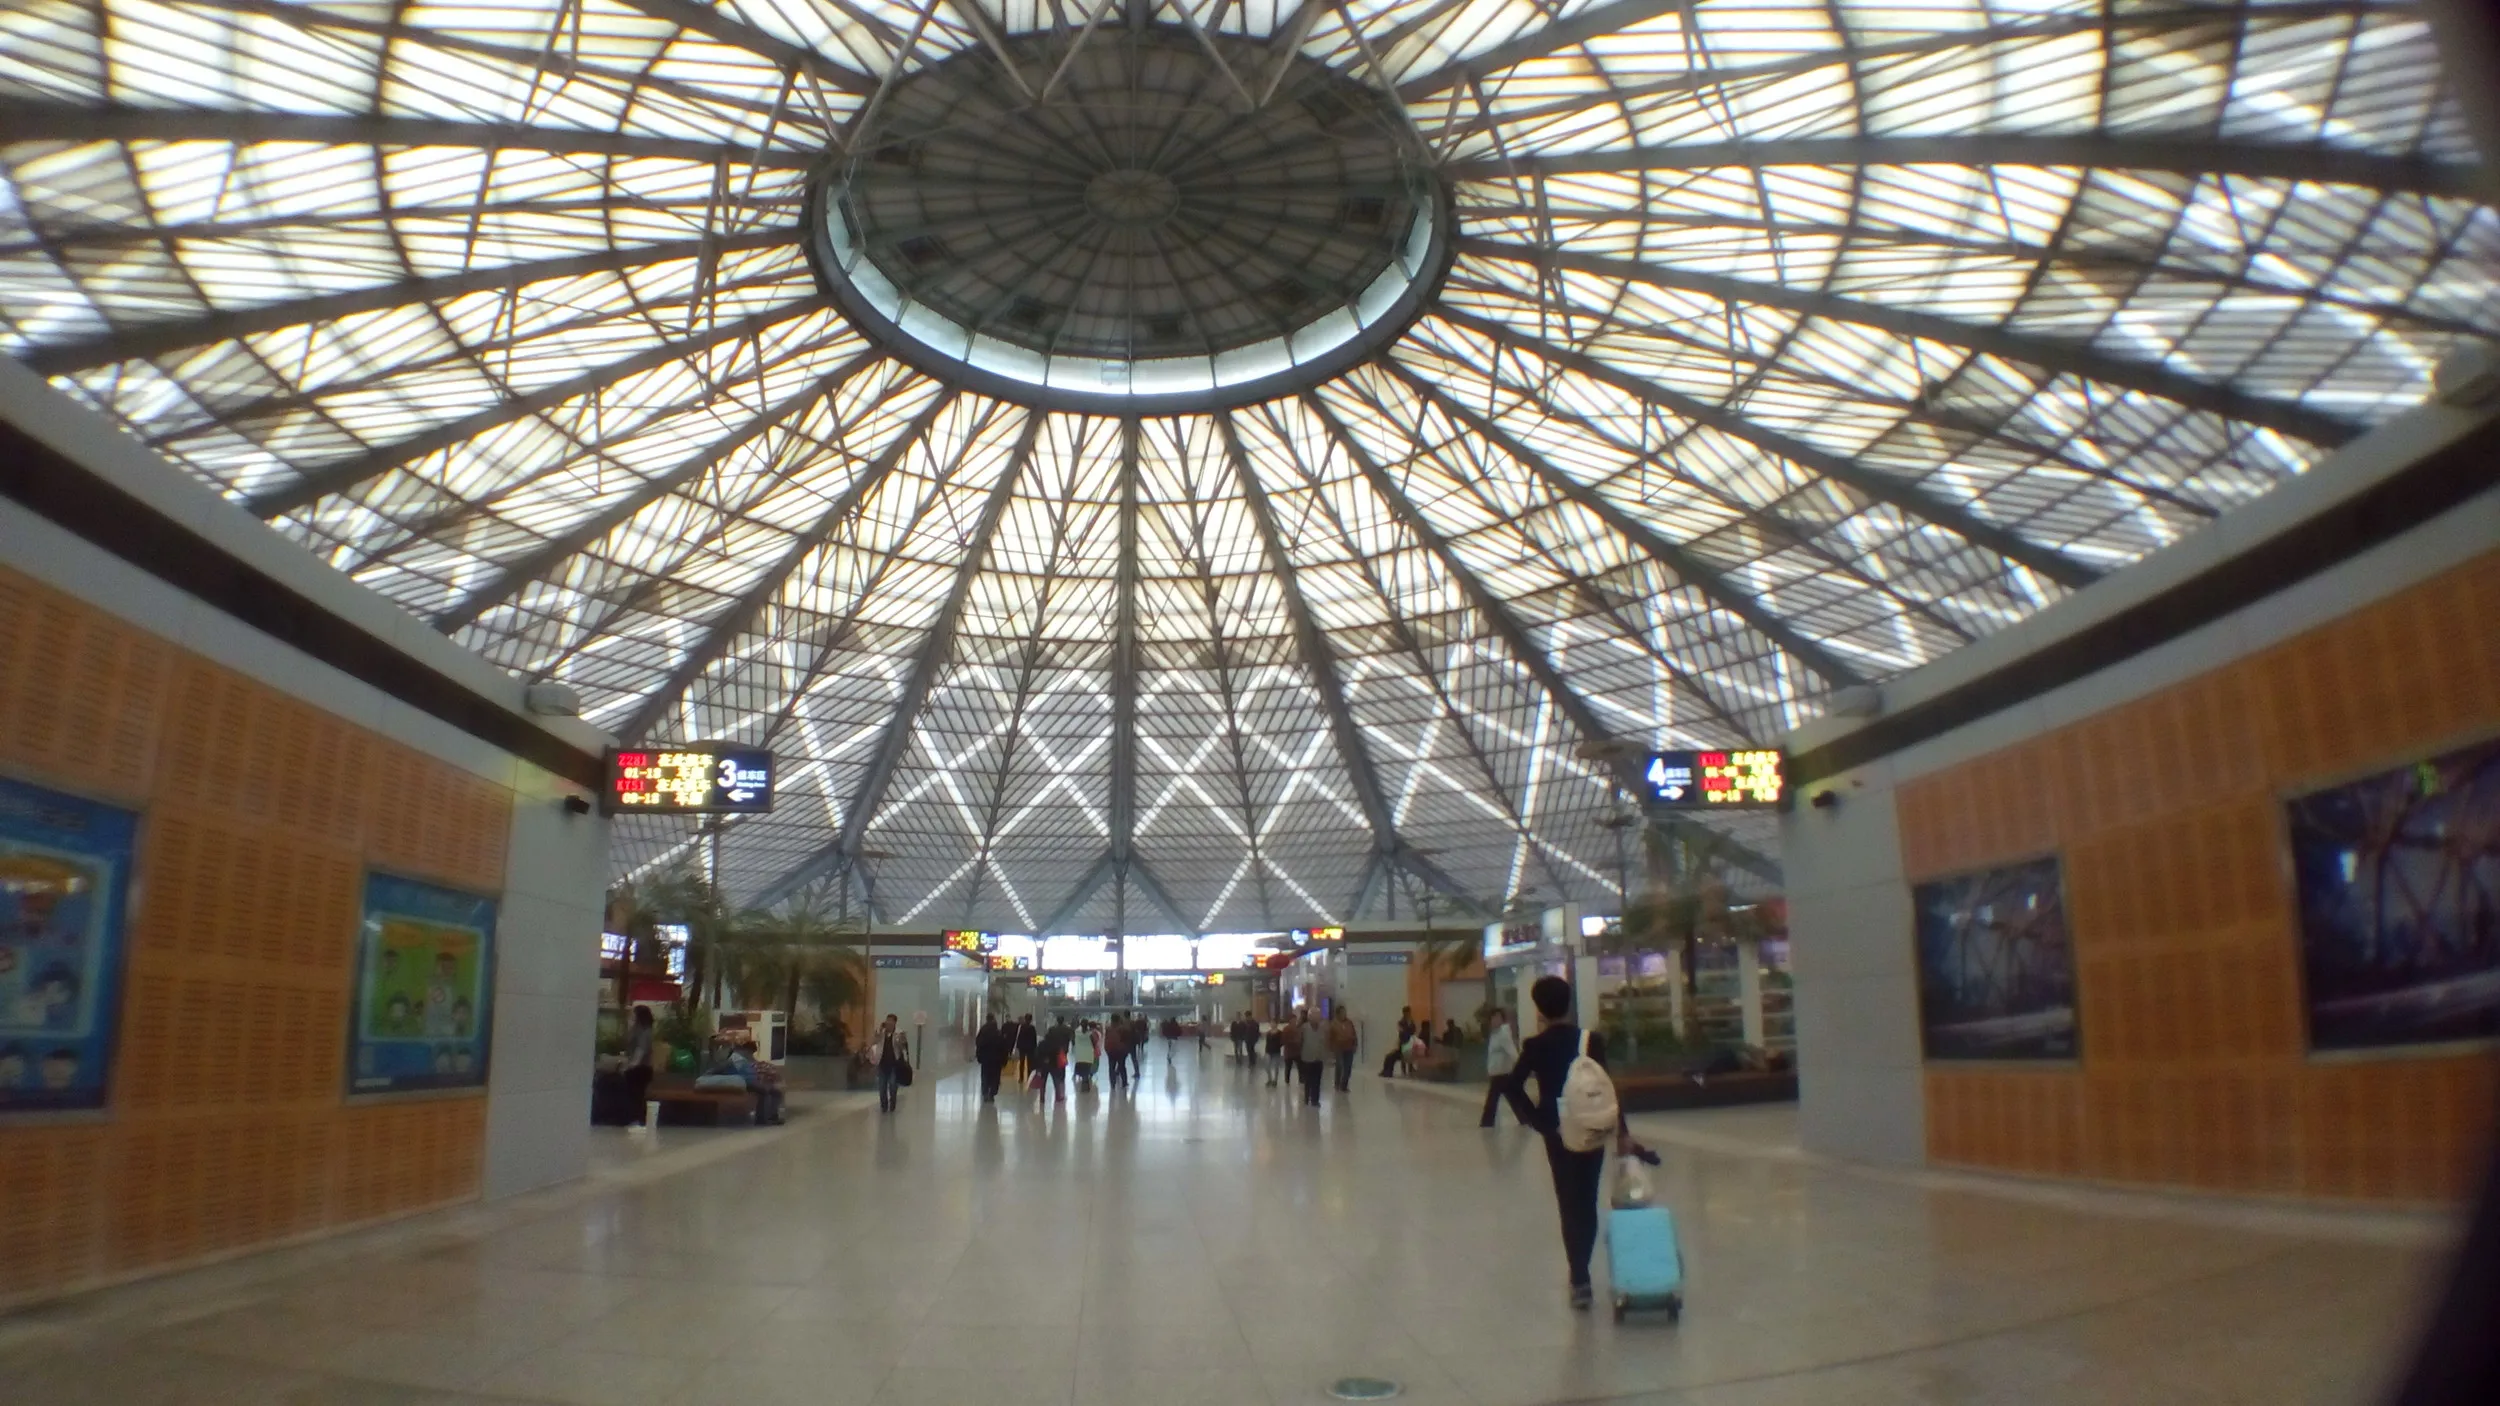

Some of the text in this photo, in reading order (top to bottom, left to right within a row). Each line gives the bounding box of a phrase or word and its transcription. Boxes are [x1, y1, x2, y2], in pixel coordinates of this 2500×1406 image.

[618, 754, 647, 766] Z281
[717, 759, 737, 788] 3
[1647, 758, 1666, 786] 4
